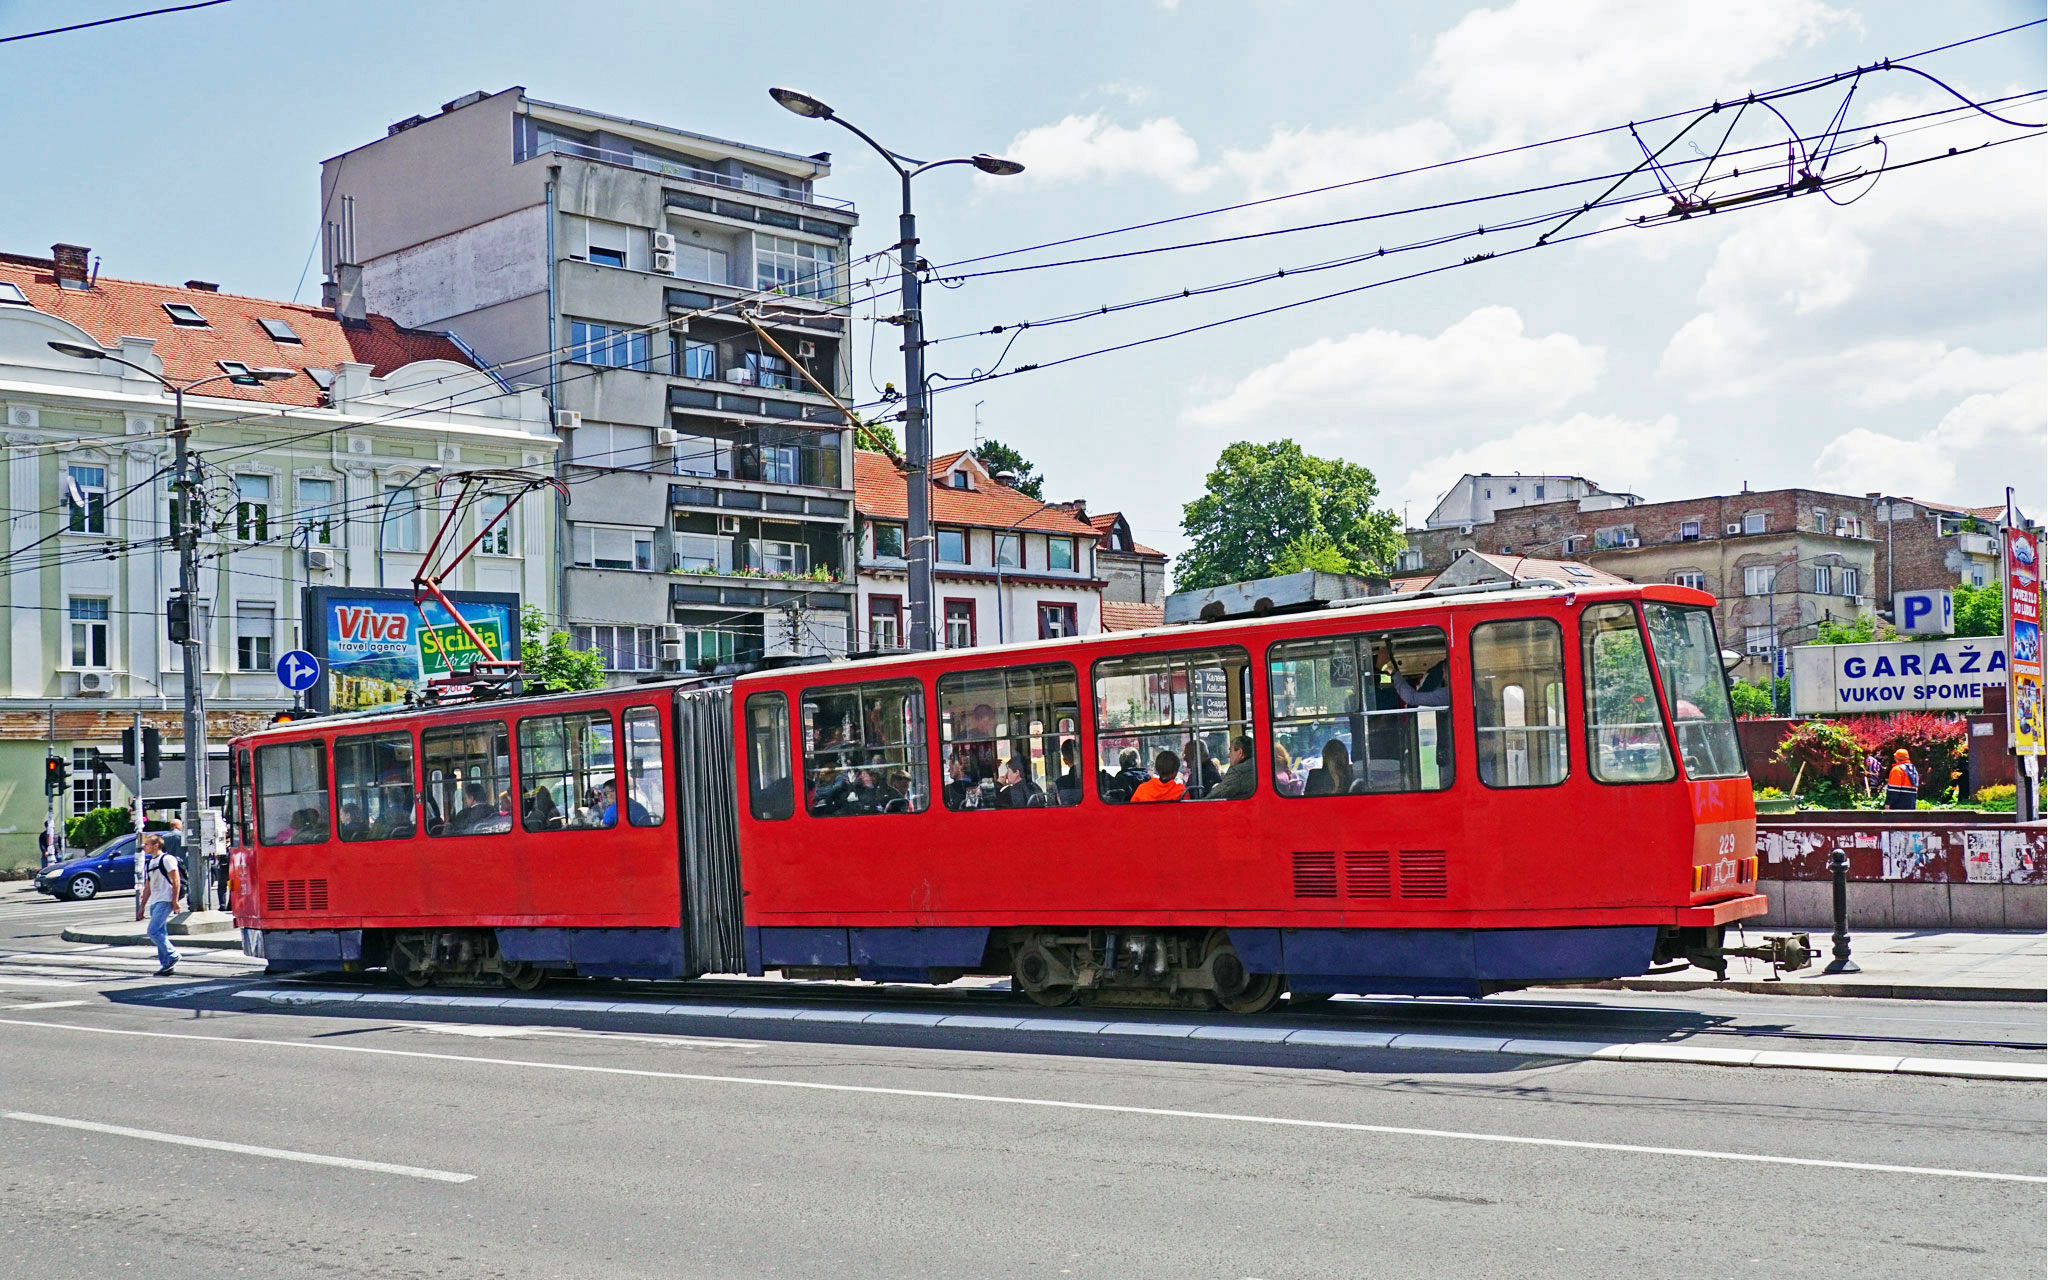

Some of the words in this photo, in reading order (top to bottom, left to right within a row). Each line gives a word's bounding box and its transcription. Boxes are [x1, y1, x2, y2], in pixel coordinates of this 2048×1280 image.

[337, 606, 408, 641] Viva
[1904, 596, 1932, 629] P
[1943, 595, 1951, 627] P
[338, 641, 368, 651] travel
[370, 643, 407, 654] agency
[1844, 645, 2006, 679] GARAŽA
[1839, 686, 1905, 703] VUKOV
[1913, 682, 2007, 700] SPOME
[1718, 833, 1735, 855] 229
